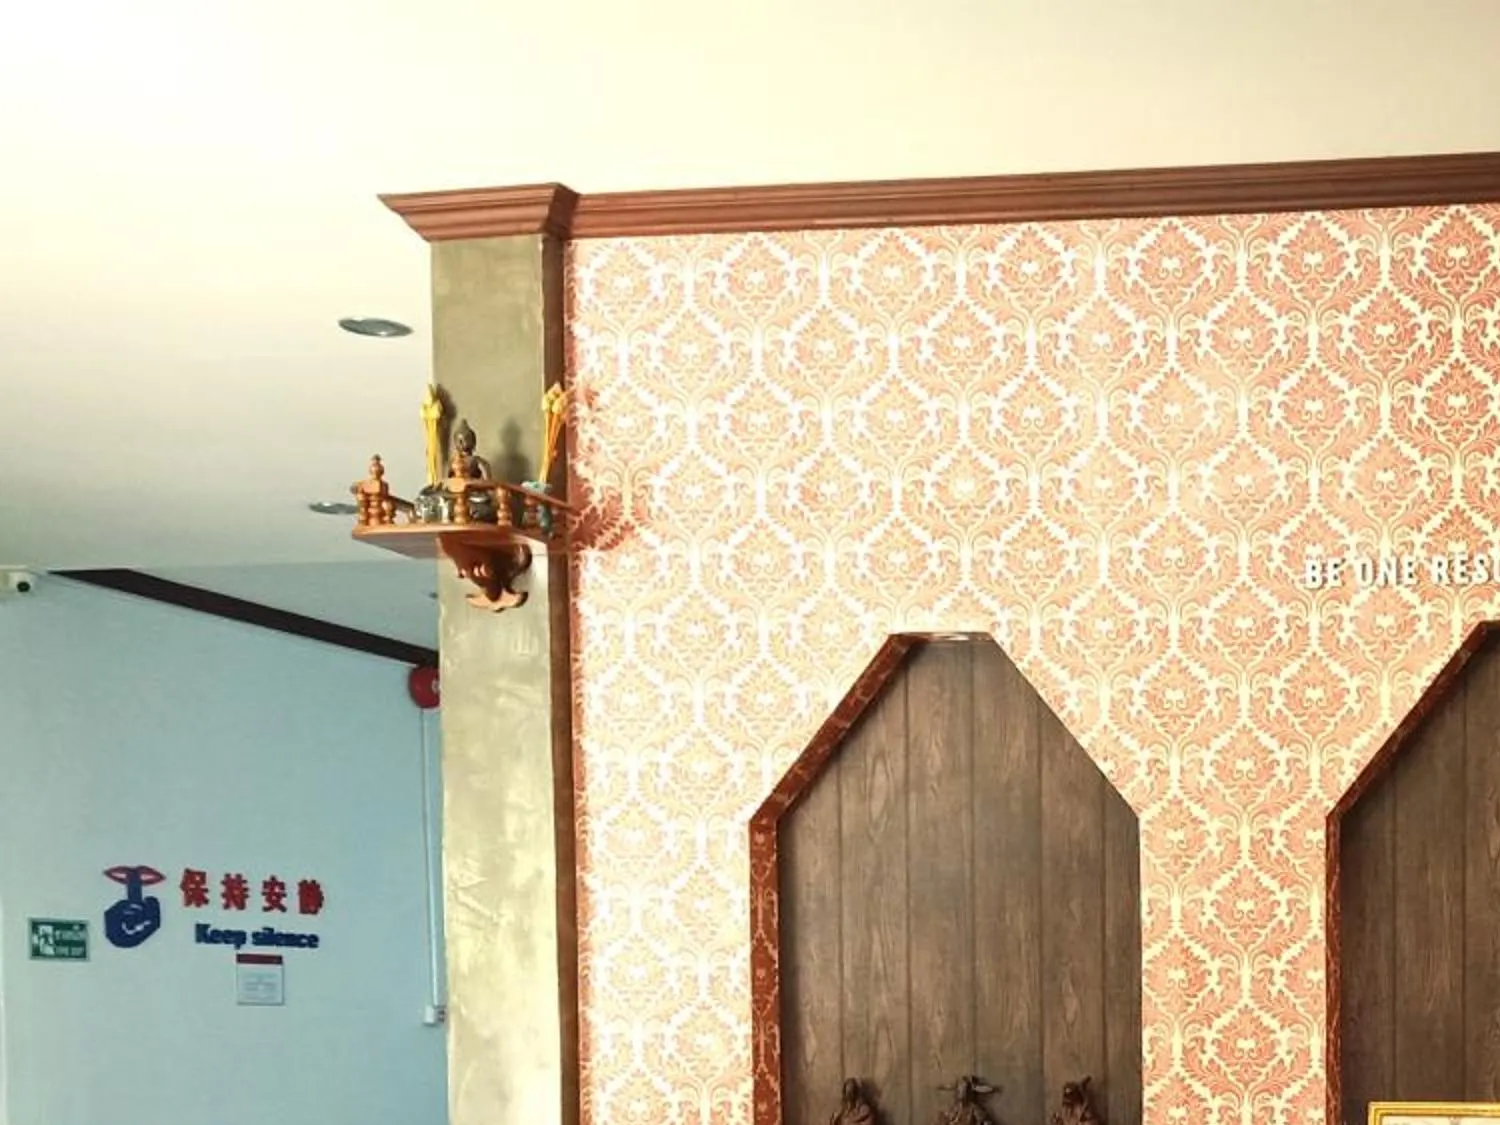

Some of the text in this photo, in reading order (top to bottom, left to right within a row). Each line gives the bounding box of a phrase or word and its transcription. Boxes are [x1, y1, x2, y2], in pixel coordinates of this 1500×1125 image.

[1304, 556, 1343, 589] BE
[1354, 553, 1418, 589] ONE
[195, 922, 319, 950] Keep silence
